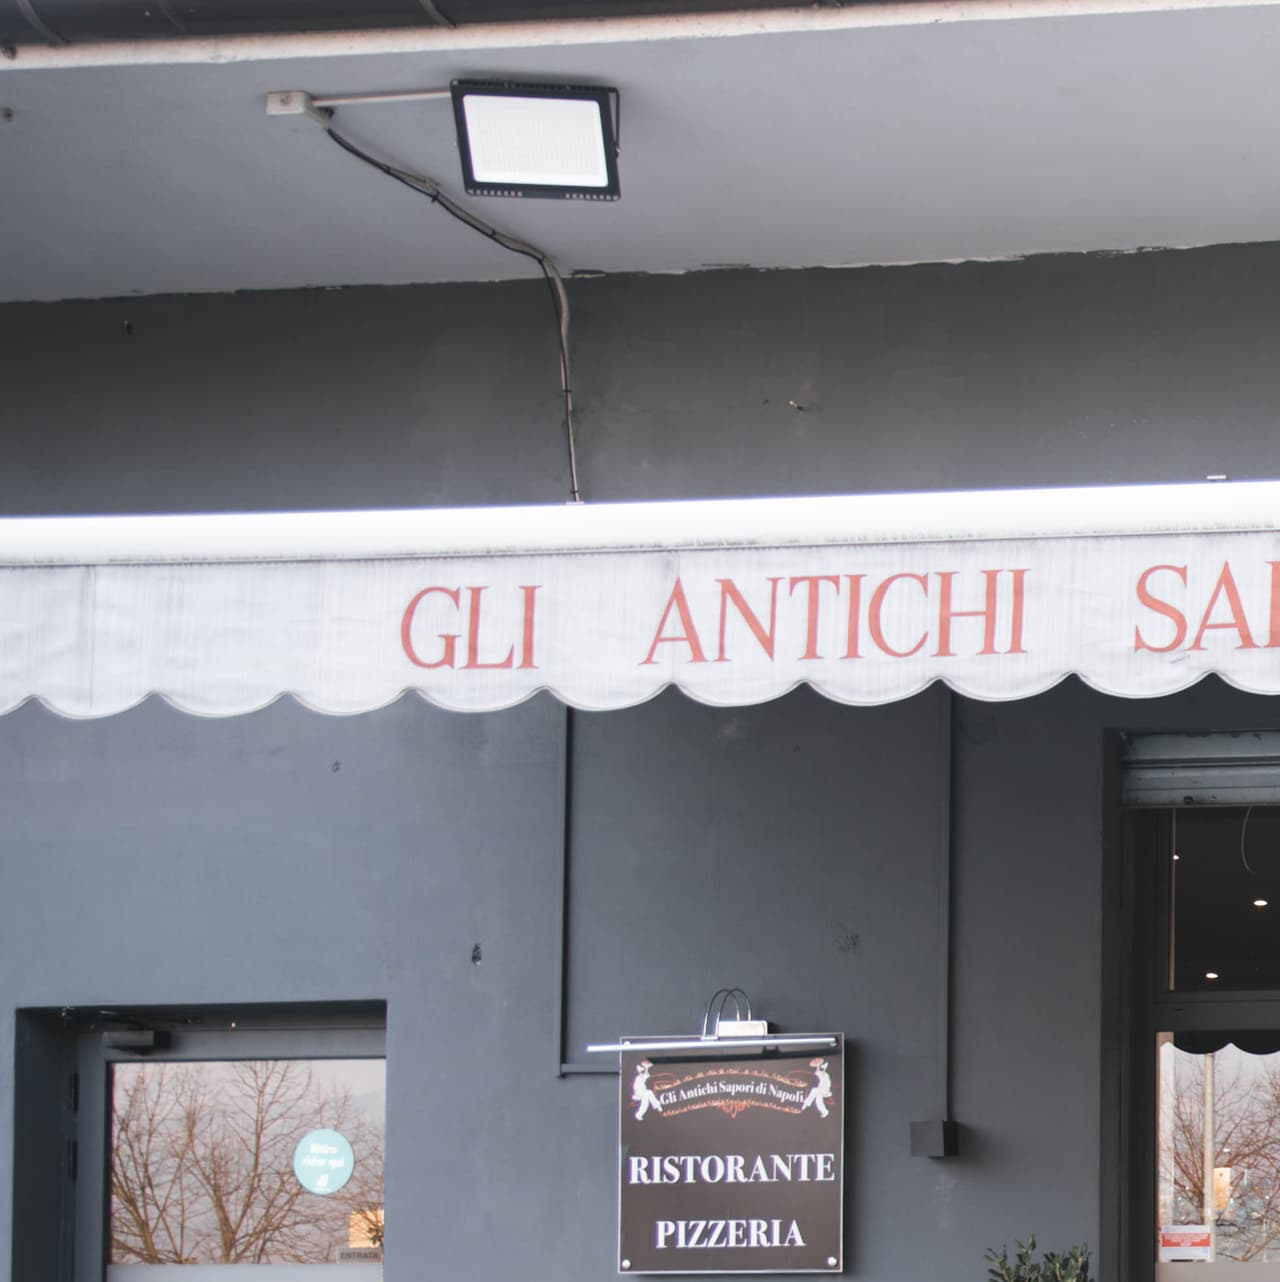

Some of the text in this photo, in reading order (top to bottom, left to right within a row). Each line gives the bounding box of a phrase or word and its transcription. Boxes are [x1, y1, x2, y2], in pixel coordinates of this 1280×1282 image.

[401, 584, 541, 670] GLI
[639, 567, 1031, 666] ANTICHI
[660, 1080, 804, 1105] Gli Antichi Sapori di Napoli
[629, 1153, 836, 1184] RISTORANTE
[655, 1219, 807, 1248] PIZZERIA
